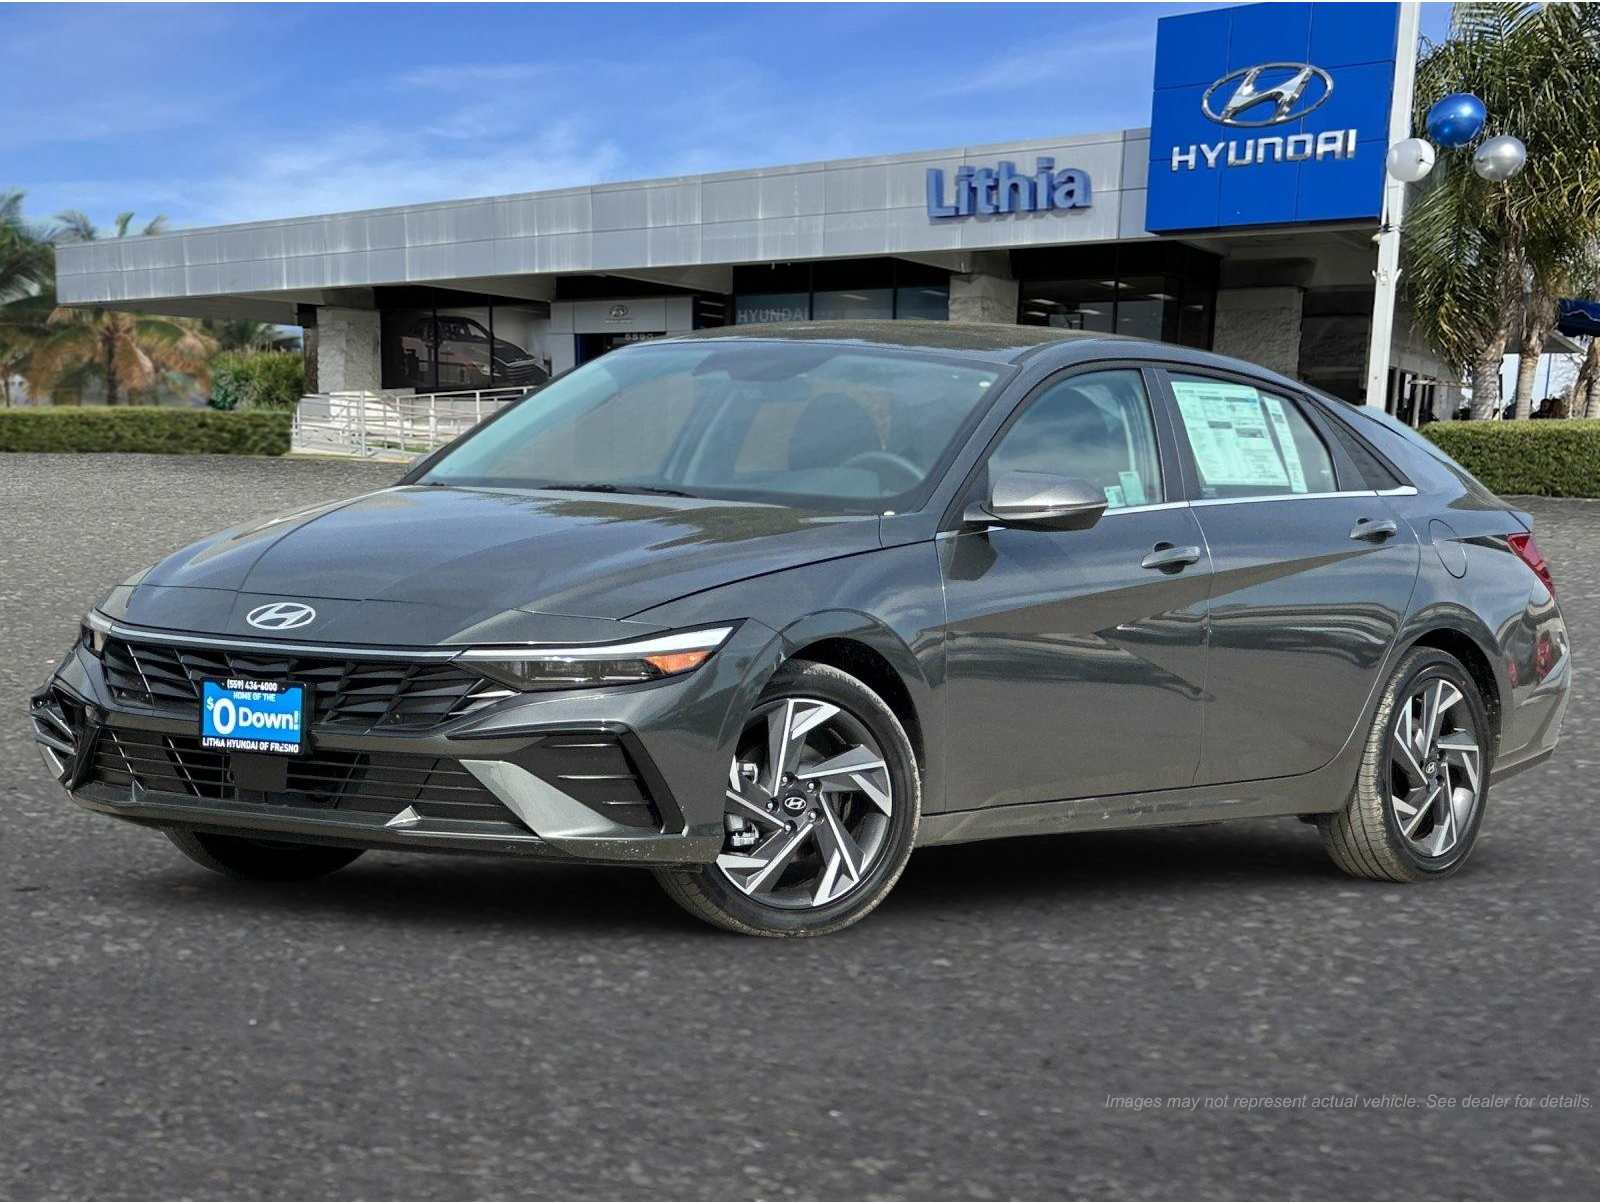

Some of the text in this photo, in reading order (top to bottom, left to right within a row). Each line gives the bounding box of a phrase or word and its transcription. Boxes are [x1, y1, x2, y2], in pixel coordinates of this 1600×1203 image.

[1171, 129, 1357, 172] HYUNDAI
[926, 157, 1092, 221] Lithia
[738, 307, 809, 323] HYUNDAI
[227, 679, 277, 691] (559) 436-6000
[233, 692, 276, 702] HOME OF THE
[238, 707, 299, 730] Down!
[203, 738, 299, 752] LITHIA HYUNDAI OF FRESNO
